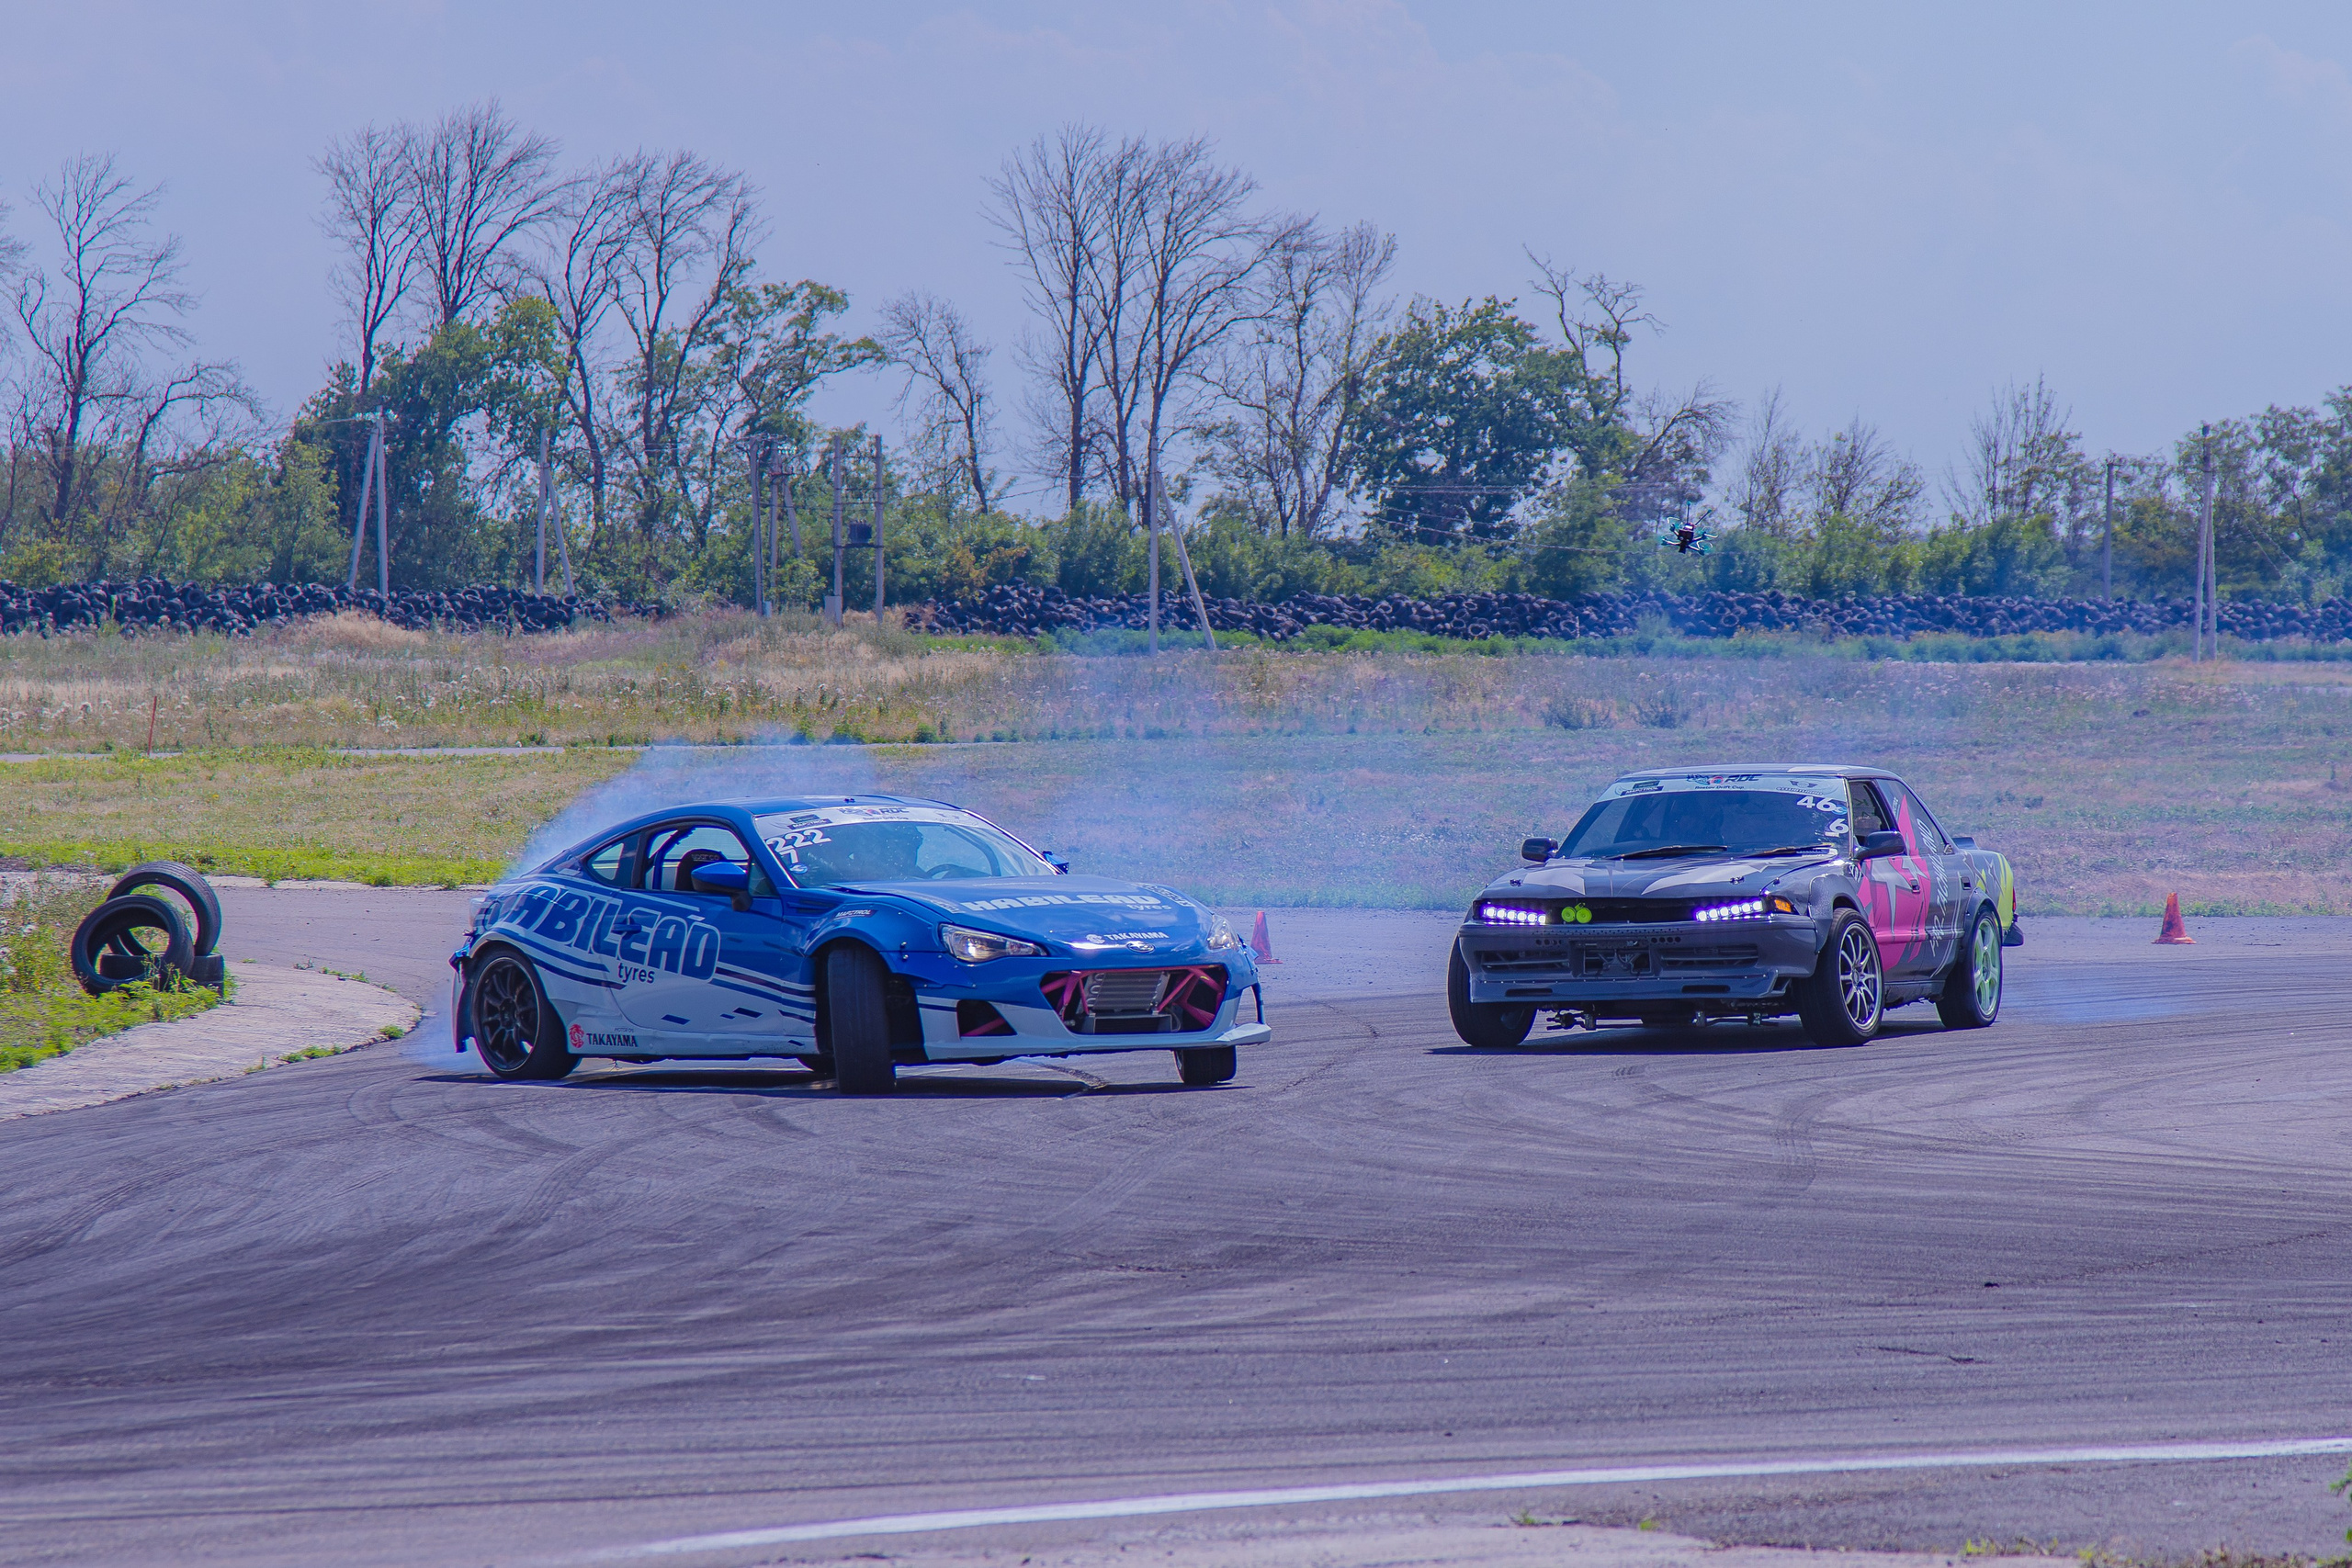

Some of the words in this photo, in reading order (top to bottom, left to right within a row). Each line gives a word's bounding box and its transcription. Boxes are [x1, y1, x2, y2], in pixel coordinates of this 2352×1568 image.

[1796, 795, 1837, 812] 46
[1829, 818, 1849, 834] 6
[765, 829, 832, 853] 222
[778, 849, 799, 864] 7
[961, 894, 1162, 911] HABILEAD
[1104, 931, 1170, 941] TAKAYAMA
[617, 963, 655, 984] tyres
[586, 1032, 639, 1047] TAKAYAMA
